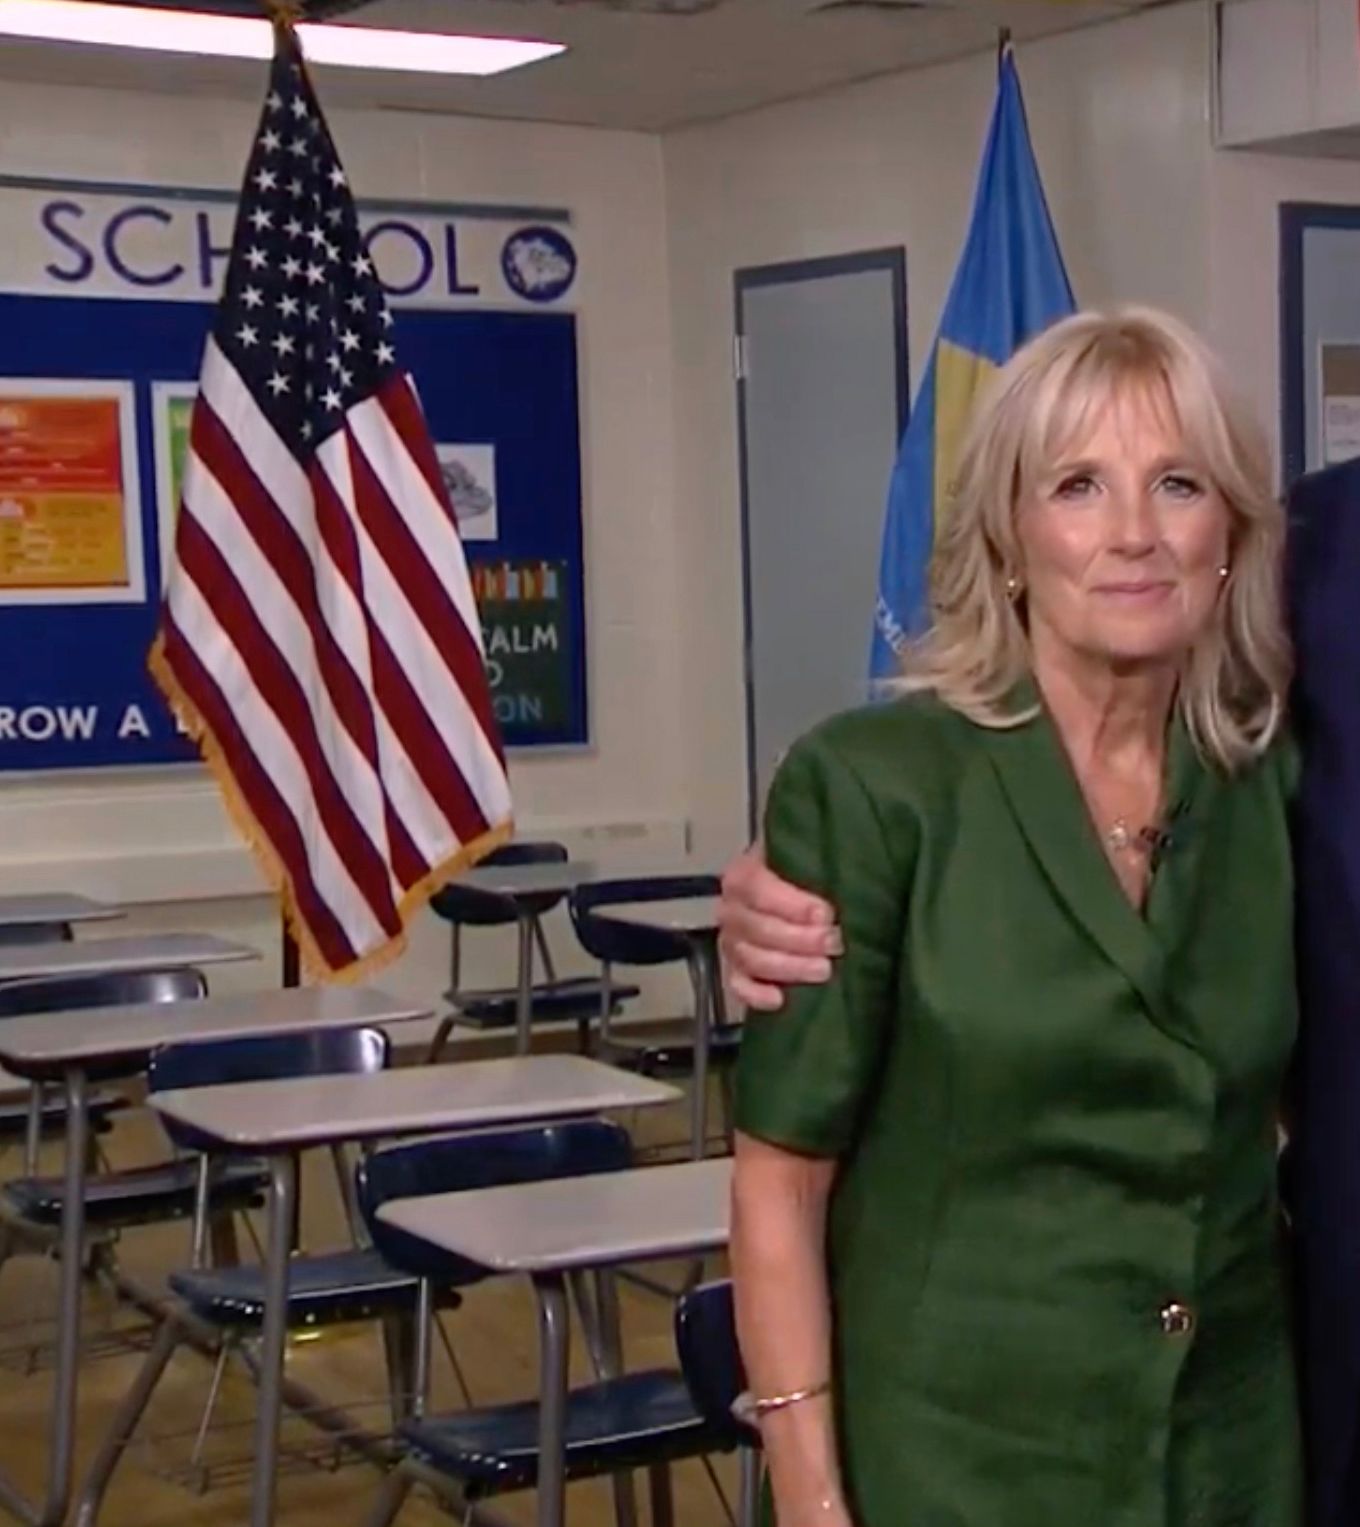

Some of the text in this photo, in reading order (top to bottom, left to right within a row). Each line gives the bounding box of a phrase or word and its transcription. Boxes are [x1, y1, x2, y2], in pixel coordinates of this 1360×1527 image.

[41, 201, 479, 295] SCHOL
[0, 704, 98, 741] ROW
[118, 704, 150, 738] A
